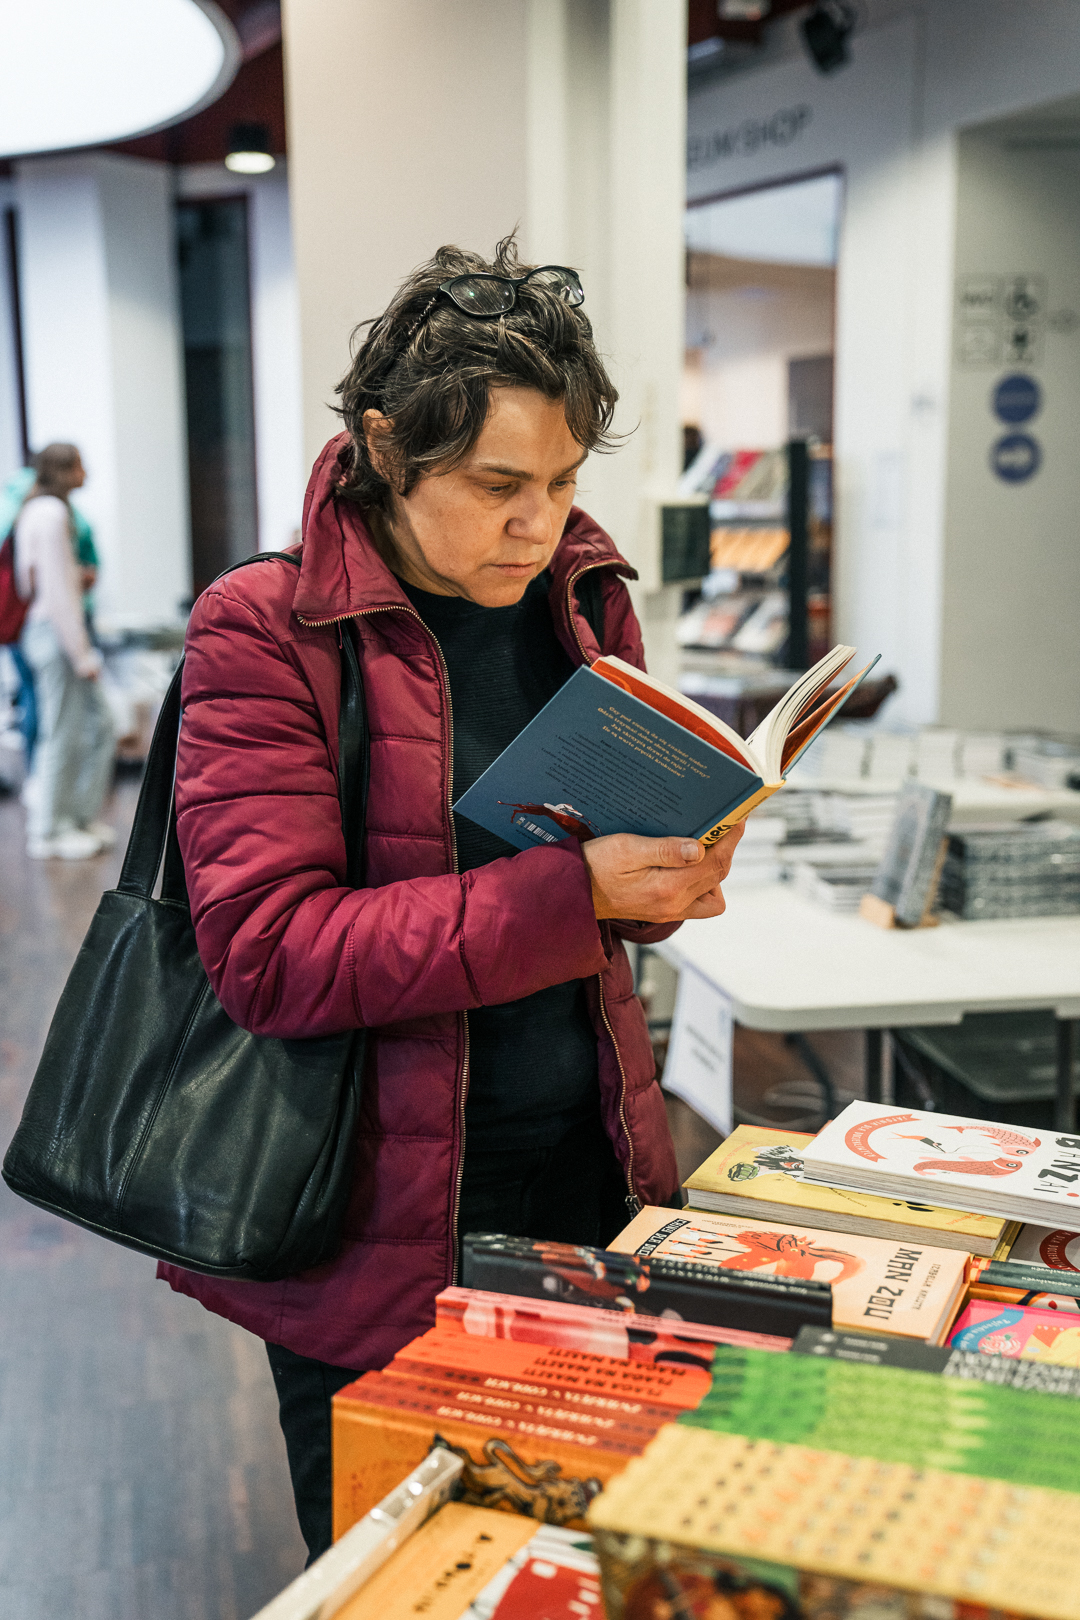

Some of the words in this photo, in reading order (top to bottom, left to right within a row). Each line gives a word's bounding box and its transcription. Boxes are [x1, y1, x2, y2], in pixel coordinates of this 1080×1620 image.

[611, 723, 621, 732] Jak
[620, 714, 632, 722] pod
[884, 1247, 923, 1283] MAN
[863, 1285, 904, 1320] ZOU
